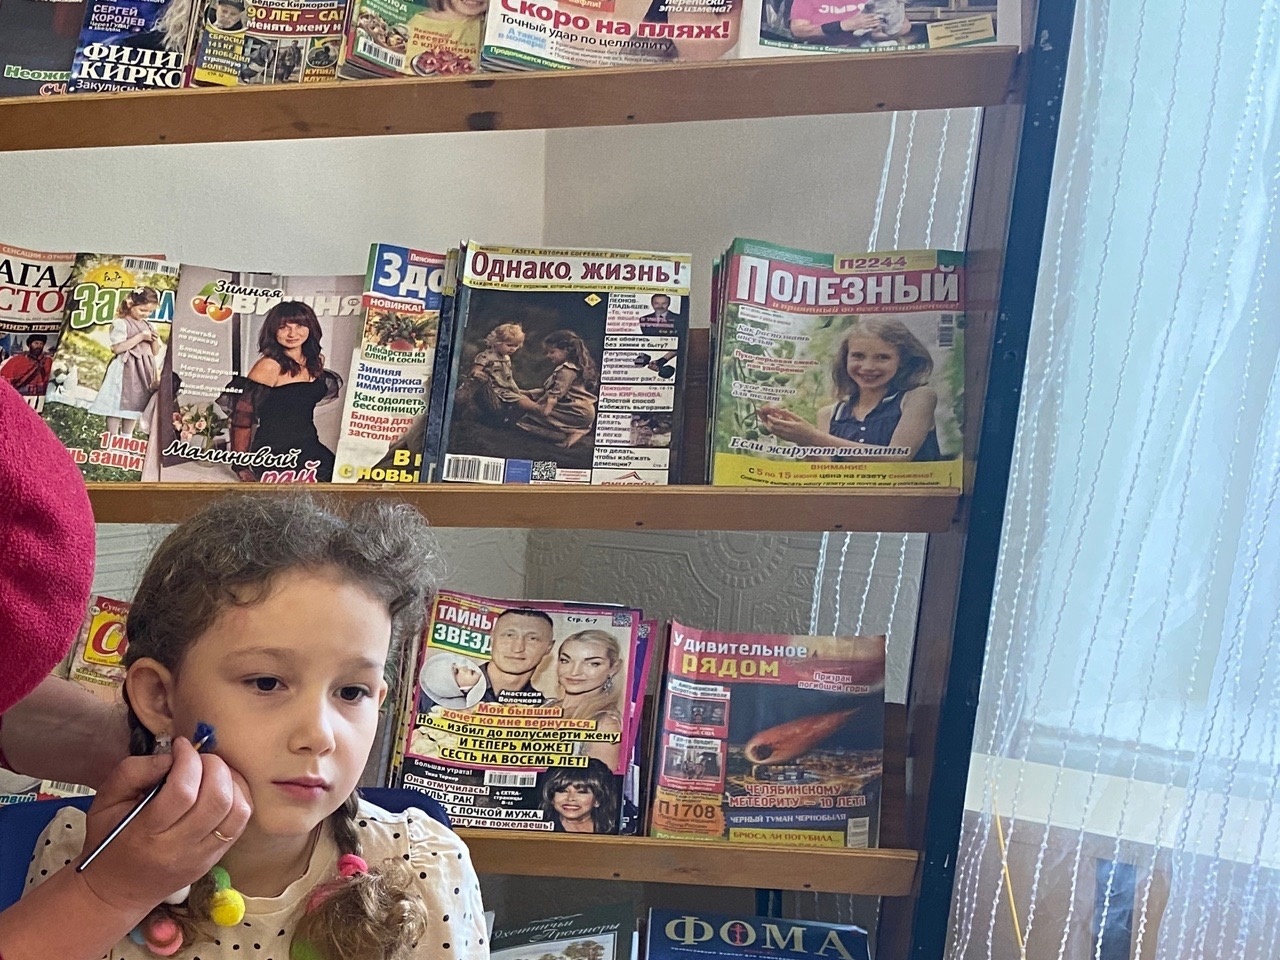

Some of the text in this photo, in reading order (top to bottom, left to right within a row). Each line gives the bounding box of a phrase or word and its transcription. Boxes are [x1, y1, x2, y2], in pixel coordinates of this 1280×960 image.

[93, 4, 138, 17] СЕРГЕЙ
[247, 7, 267, 19] 90
[269, 9, 301, 22] ЛЕТ
[684, 5, 732, 13] измена?
[91, 13, 146, 27] КОРОЛЕВ
[501, 0, 590, 30] Скоро
[595, 20, 631, 36] на
[638, 20, 730, 39] пляж!
[296, 23, 331, 35] жену
[501, 13, 673, 52] Точный удар по целлюлиту
[78, 61, 183, 88] КИРКО
[471, 251, 681, 284] Однако, жизнь!
[839, 256, 907, 270] П2244
[214, 279, 283, 299] Зимняя
[370, 298, 424, 312] НОВИНКА!
[364, 352, 387, 361] елки
[396, 356, 426, 364] сосны
[365, 344, 413, 358] Лекарства
[357, 362, 402, 377] Зимняя
[356, 373, 422, 386] поддержка
[355, 381, 425, 394] иммунитета
[354, 391, 425, 406] Как одолеть
[352, 401, 426, 416] бессонницу?
[350, 411, 414, 426] Блюда для
[349, 420, 408, 433] полезного
[100, 432, 110, 449] 1
[348, 429, 400, 441] застолья
[162, 440, 302, 469] Малиновый
[731, 437, 910, 458] Если жируют томаты
[392, 449, 411, 466] В
[260, 460, 321, 483] рай
[567, 616, 598, 625] Стр. 6-7
[673, 631, 807, 658] Удивительное
[681, 653, 779, 679] рядом
[814, 672, 851, 682] Призрак
[500, 690, 542, 698] Анастасия
[799, 681, 869, 693] погибшей горы
[498, 696, 542, 704] Волочкова
[478, 703, 560, 716] Мой бывший
[442, 710, 594, 729] хочет ко мне вернуться.
[418, 714, 620, 743] Но... избил до полусмерти жену
[460, 738, 571, 752] И ТЕПЕРЬ МОЖЕТ
[441, 747, 586, 766] СЕСТЬ НА ВОСЕМЬ ЛЕТ!
[414, 760, 472, 776] Большая утрата!
[405, 774, 489, 794] Она отмучилась!
[745, 784, 842, 796] ЧЕЛЯБИНСКОМУ
[453, 795, 473, 804] РАК
[730, 796, 866, 808] МЕТЕОРИТУ 10 ЛЕТ!
[459, 806, 502, 817] ПОЧКОЙ
[505, 810, 541, 819] МУЖА.
[659, 800, 716, 819] П1708
[451, 817, 472, 827] рагу
[490, 821, 554, 830] пожелаешь!
[730, 815, 764, 823] ЧЕРНЫЙ
[795, 813, 846, 822] ЧЕРНОБЫЛЯ
[733, 832, 767, 840] БРЮСА
[529, 923, 620, 942] Просторы
